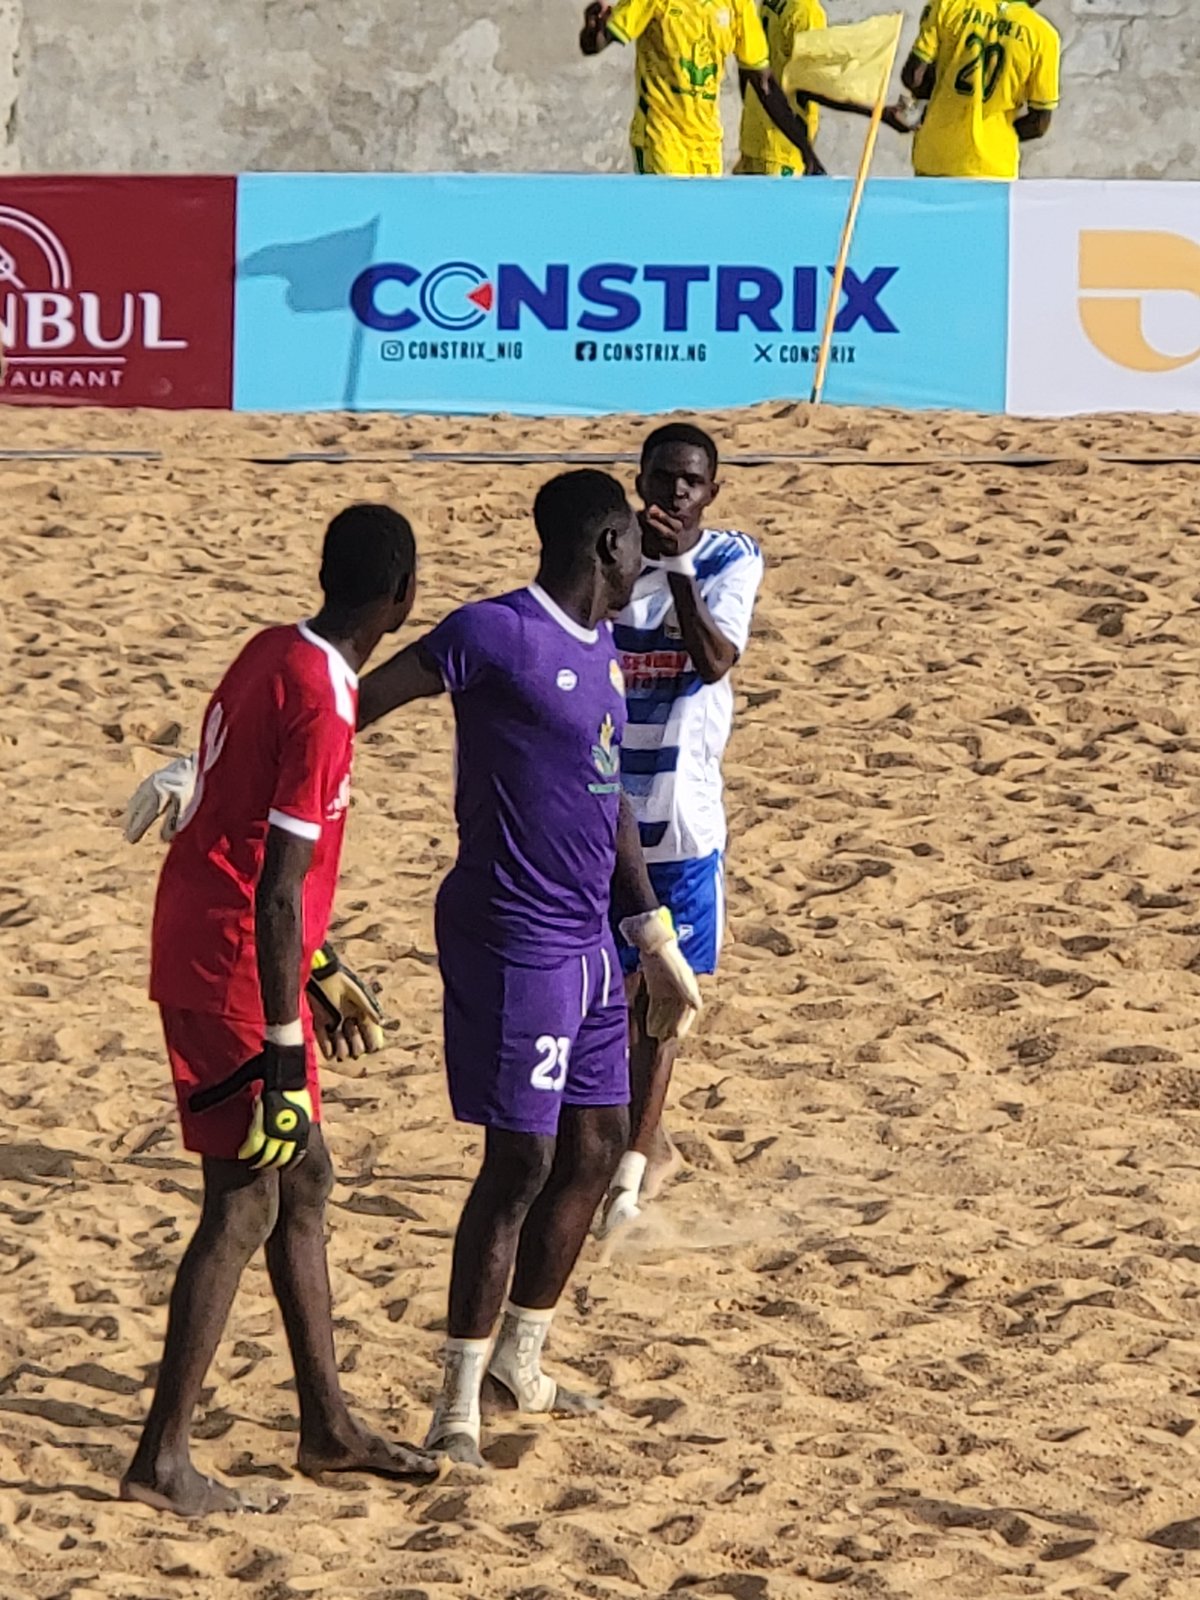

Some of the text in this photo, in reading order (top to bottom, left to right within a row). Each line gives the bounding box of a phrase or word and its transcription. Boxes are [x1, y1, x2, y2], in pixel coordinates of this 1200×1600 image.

[955, 32, 1005, 103] 20
[349, 261, 900, 333] CONSTRIX
[408, 341, 523, 362] CONSTRIX_NIG
[779, 344, 856, 364] CONSRIX
